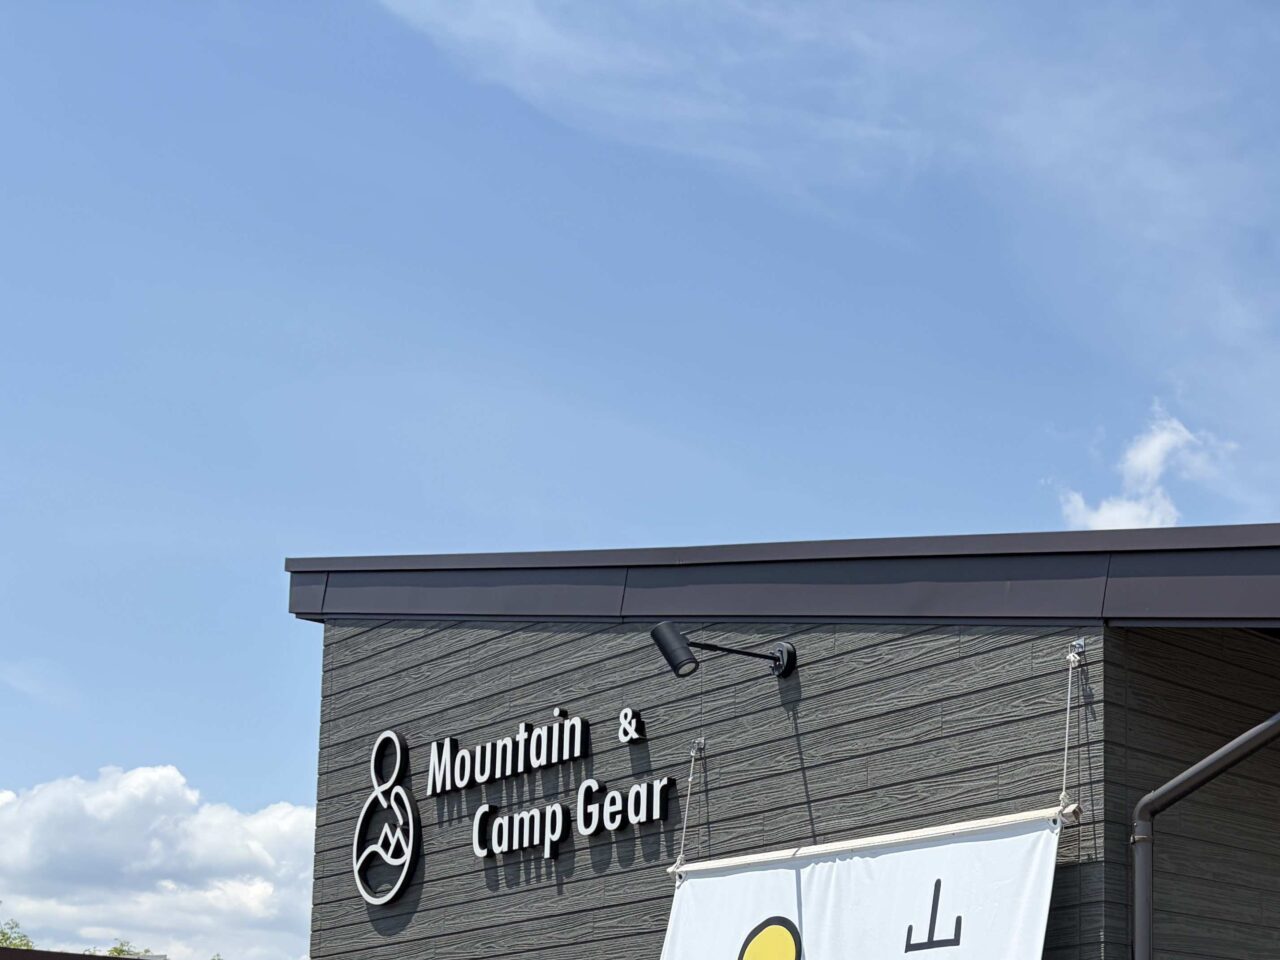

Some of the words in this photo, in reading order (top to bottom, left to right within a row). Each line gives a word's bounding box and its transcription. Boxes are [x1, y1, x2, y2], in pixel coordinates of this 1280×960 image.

[427, 707, 584, 797] Mountain
[618, 707, 642, 744] &
[472, 803, 564, 859] Camp
[576, 776, 670, 837] Gear
